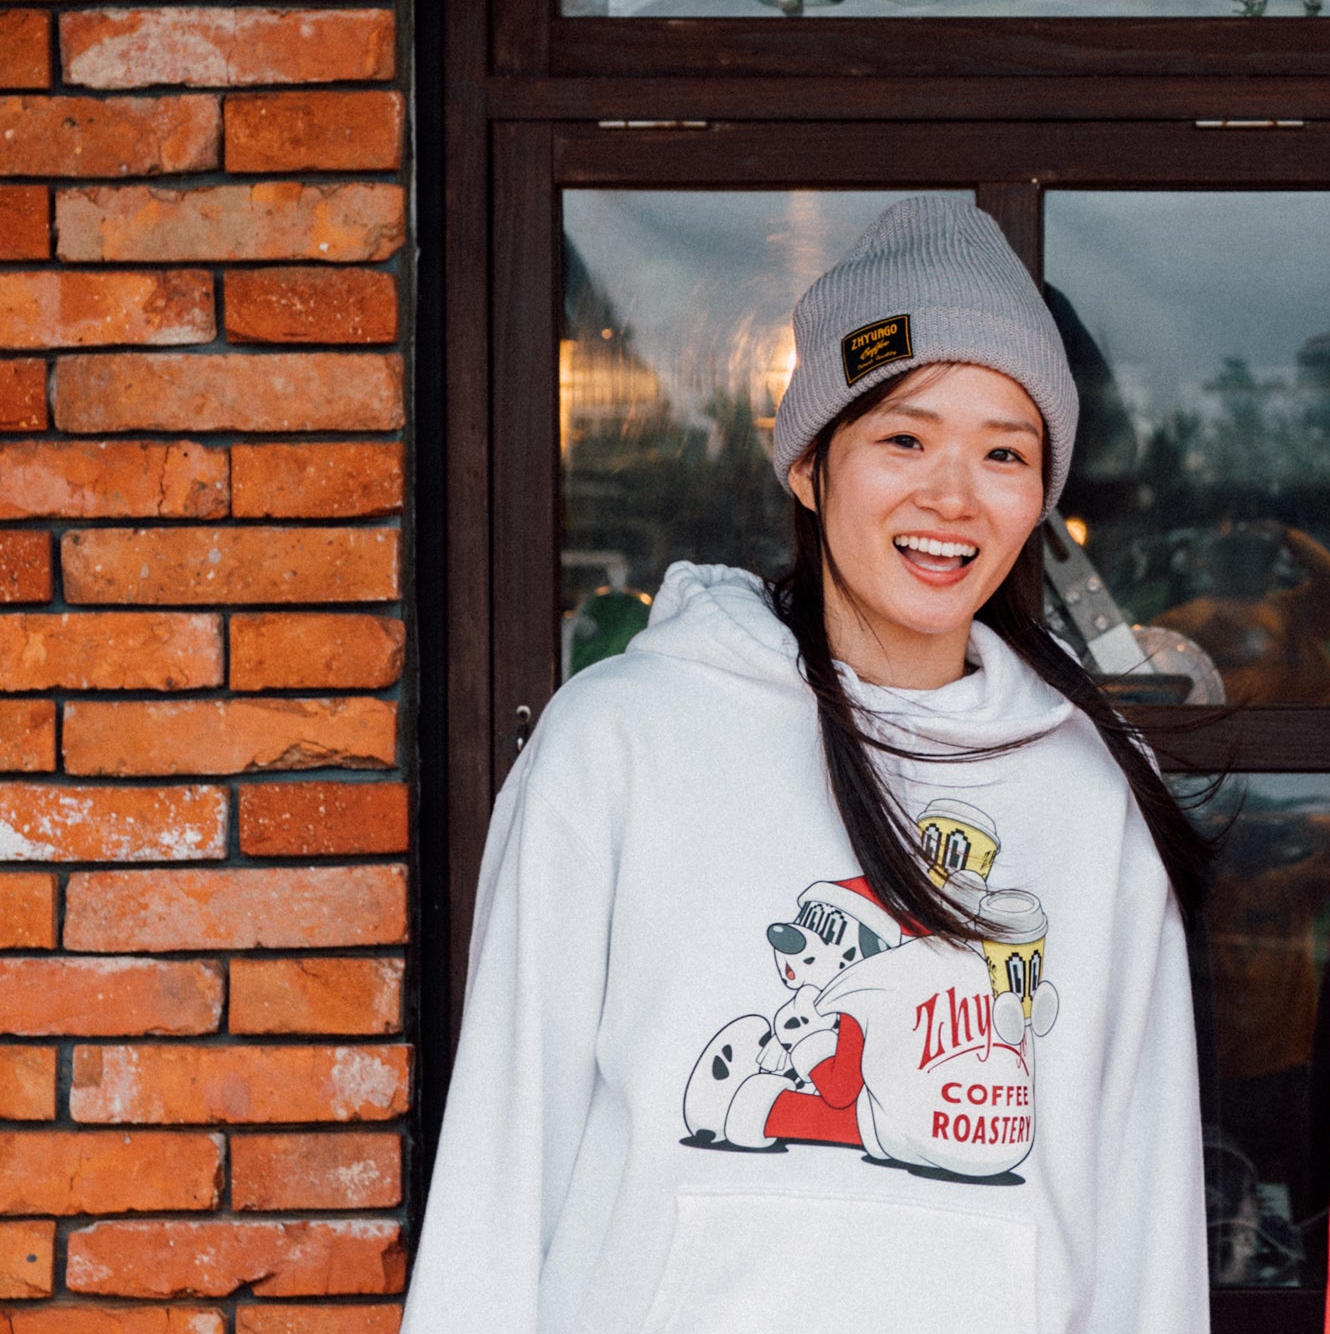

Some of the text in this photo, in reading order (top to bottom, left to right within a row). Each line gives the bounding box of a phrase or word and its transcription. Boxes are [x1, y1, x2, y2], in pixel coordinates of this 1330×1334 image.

[912, 986, 1006, 1071] Zhy
[941, 1082, 1029, 1107] COFFEE
[931, 1110, 1032, 1145] ROASTERY
